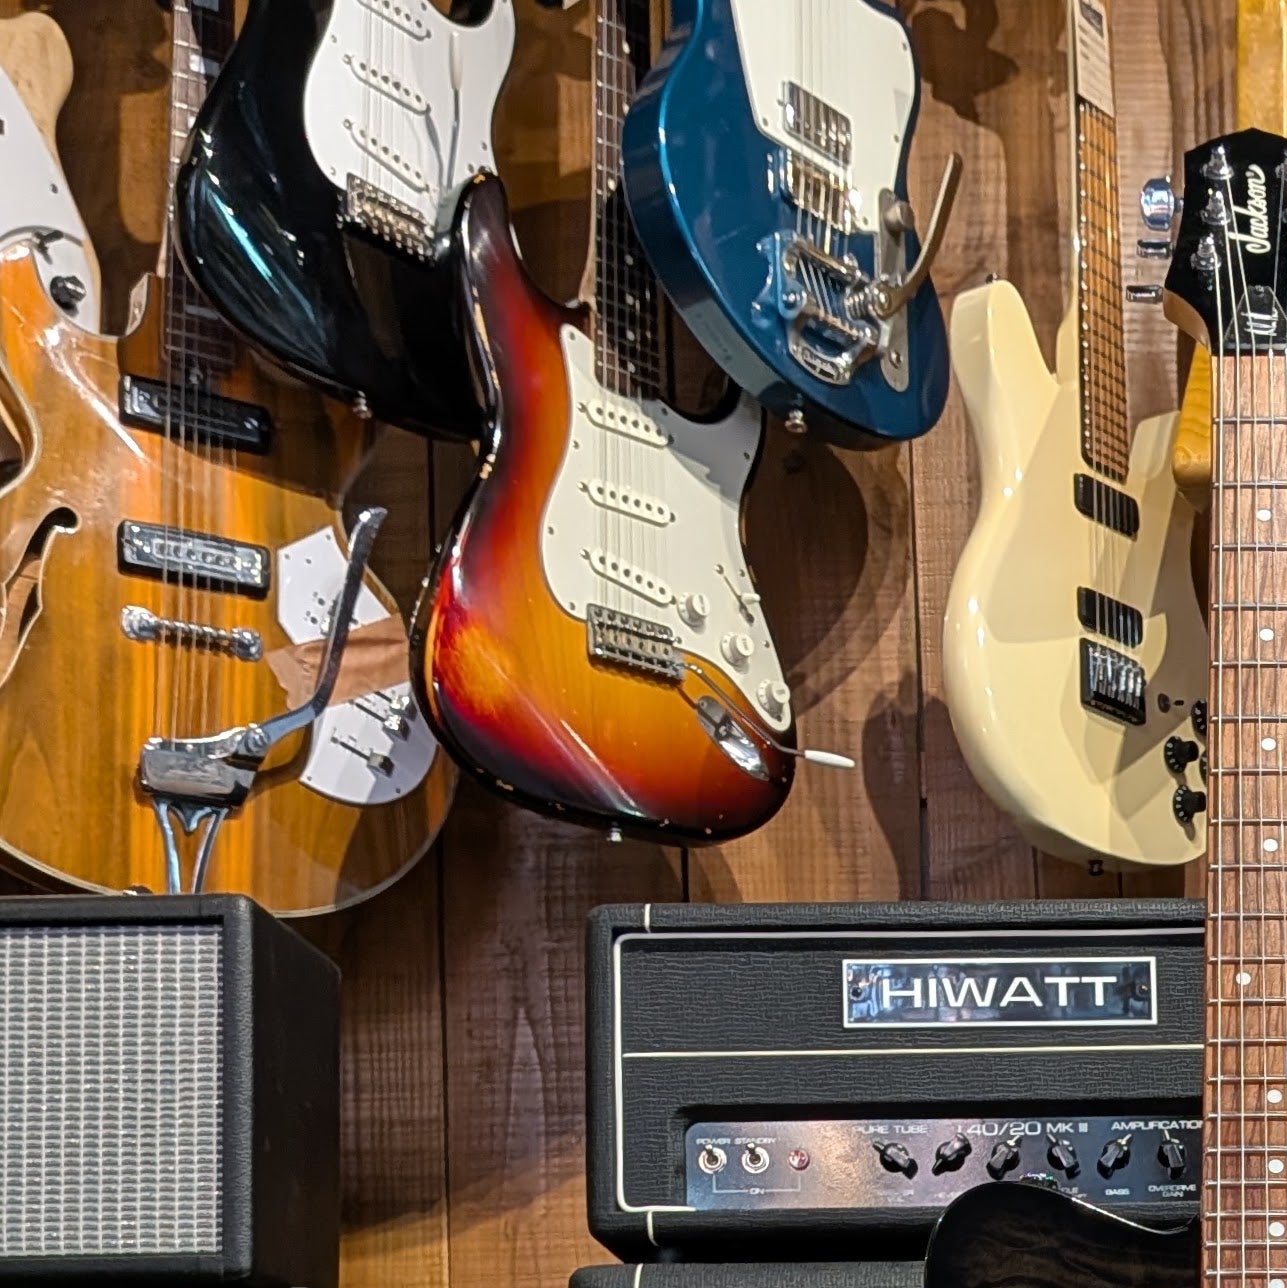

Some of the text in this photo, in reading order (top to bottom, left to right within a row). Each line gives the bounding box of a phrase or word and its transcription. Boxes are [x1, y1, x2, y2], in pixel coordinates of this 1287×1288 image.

[1228, 164, 1271, 254] Jackson
[882, 976, 1117, 1008] HIWATT
[894, 1125, 928, 1134] TUBE
[1046, 1123, 1075, 1133] MK
[734, 1137, 776, 1145] STANDBY
[1105, 1188, 1130, 1196] BASS
[1148, 1183, 1197, 1193] OVERDRIVE
